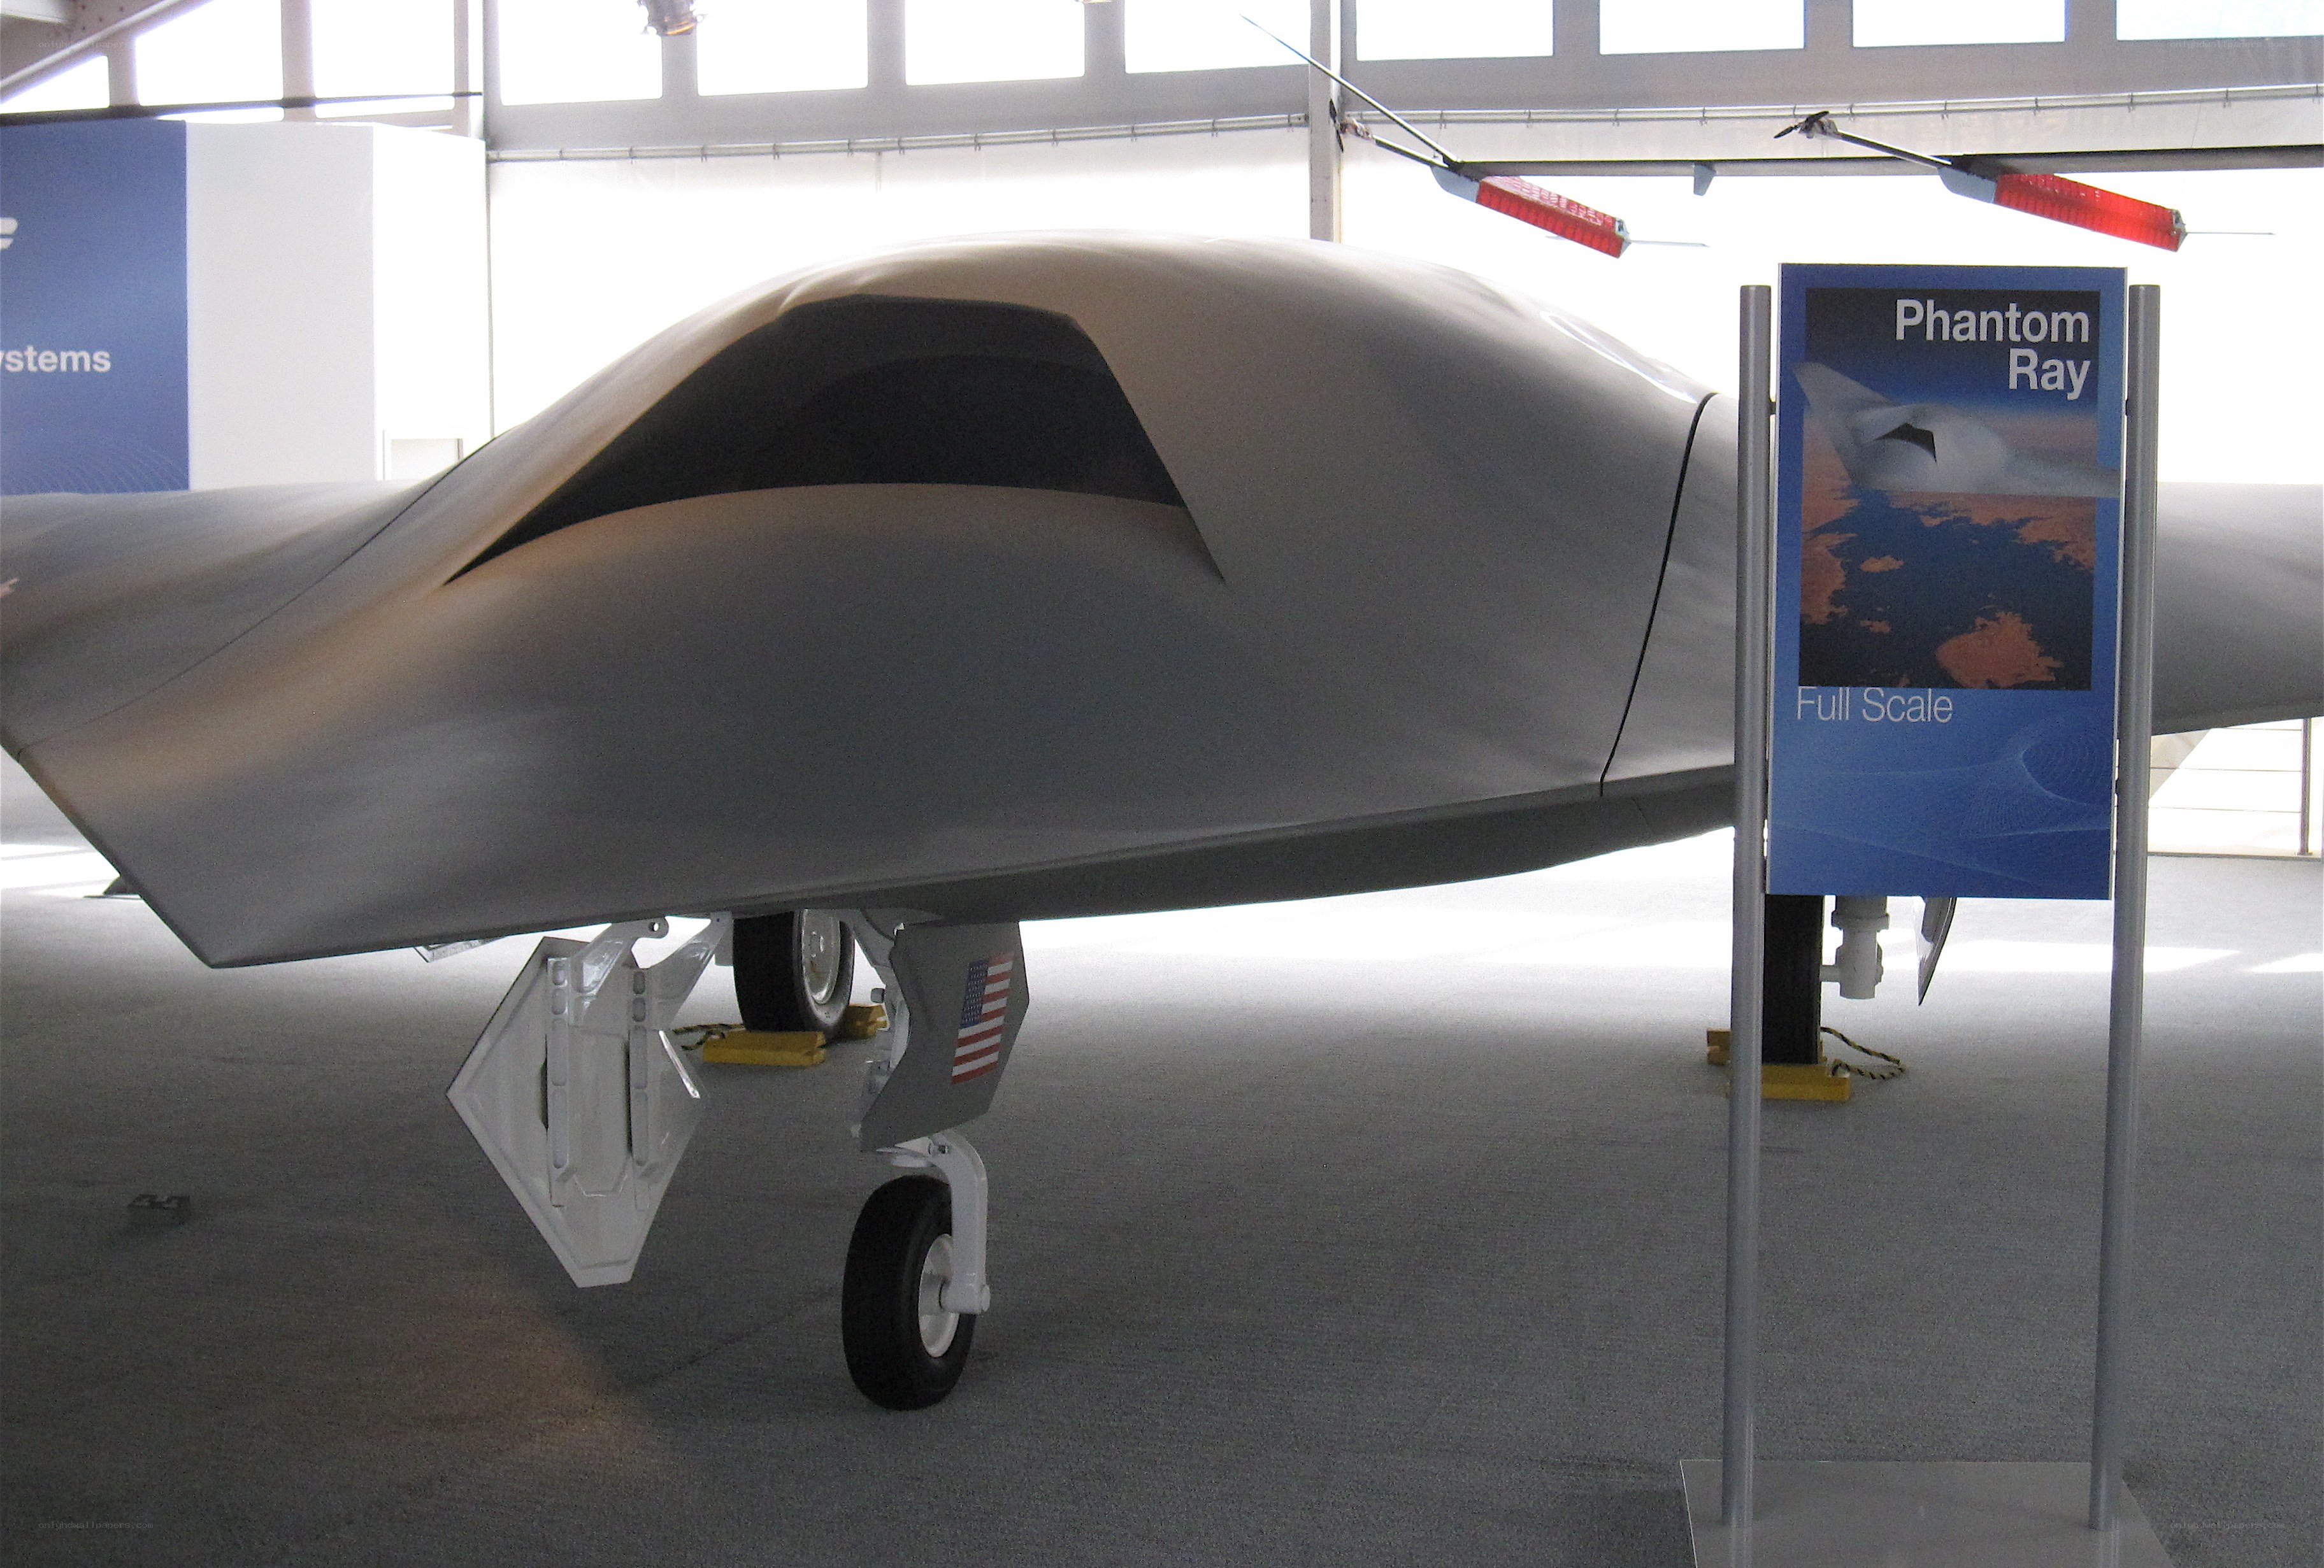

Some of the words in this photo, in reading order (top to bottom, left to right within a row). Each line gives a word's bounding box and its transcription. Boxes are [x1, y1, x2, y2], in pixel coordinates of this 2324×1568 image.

[1895, 298, 2090, 343] Phantom
[0, 345, 111, 373] stems
[2009, 347, 2091, 401] Ray
[1797, 686, 1849, 721] Full
[1862, 687, 1953, 723] Scale
